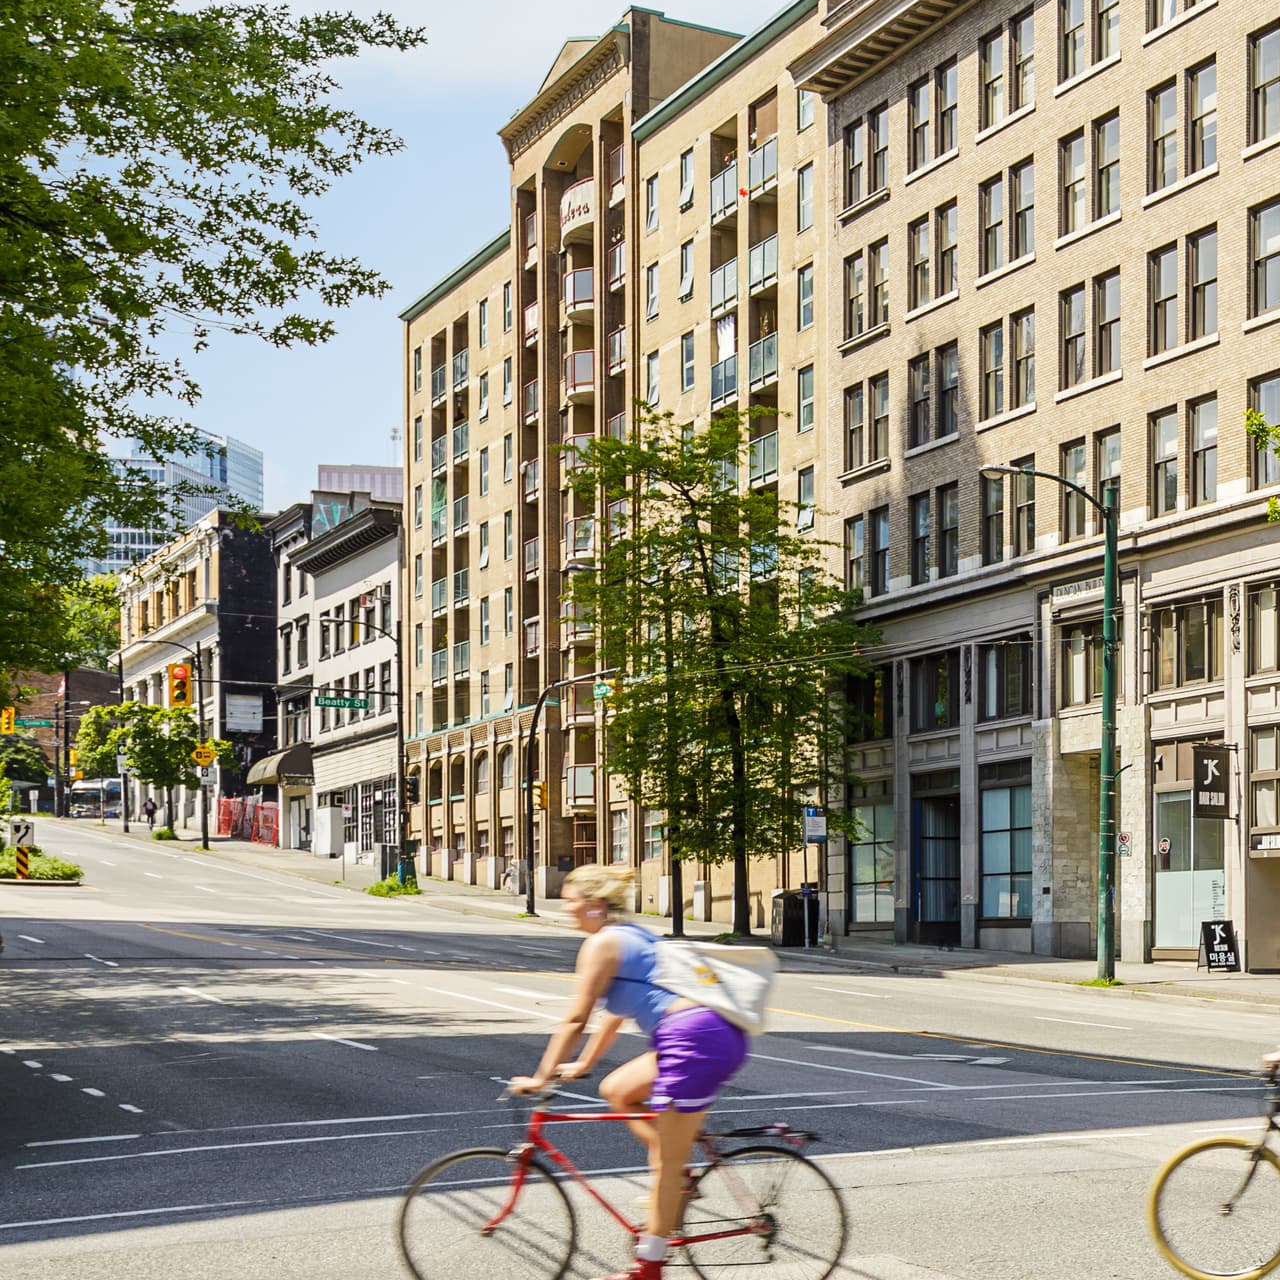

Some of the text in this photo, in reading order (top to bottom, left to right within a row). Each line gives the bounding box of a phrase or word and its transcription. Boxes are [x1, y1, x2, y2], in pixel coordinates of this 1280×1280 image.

[318, 697, 366, 708] Beatty St
[1209, 952, 1235, 963] 미용실
